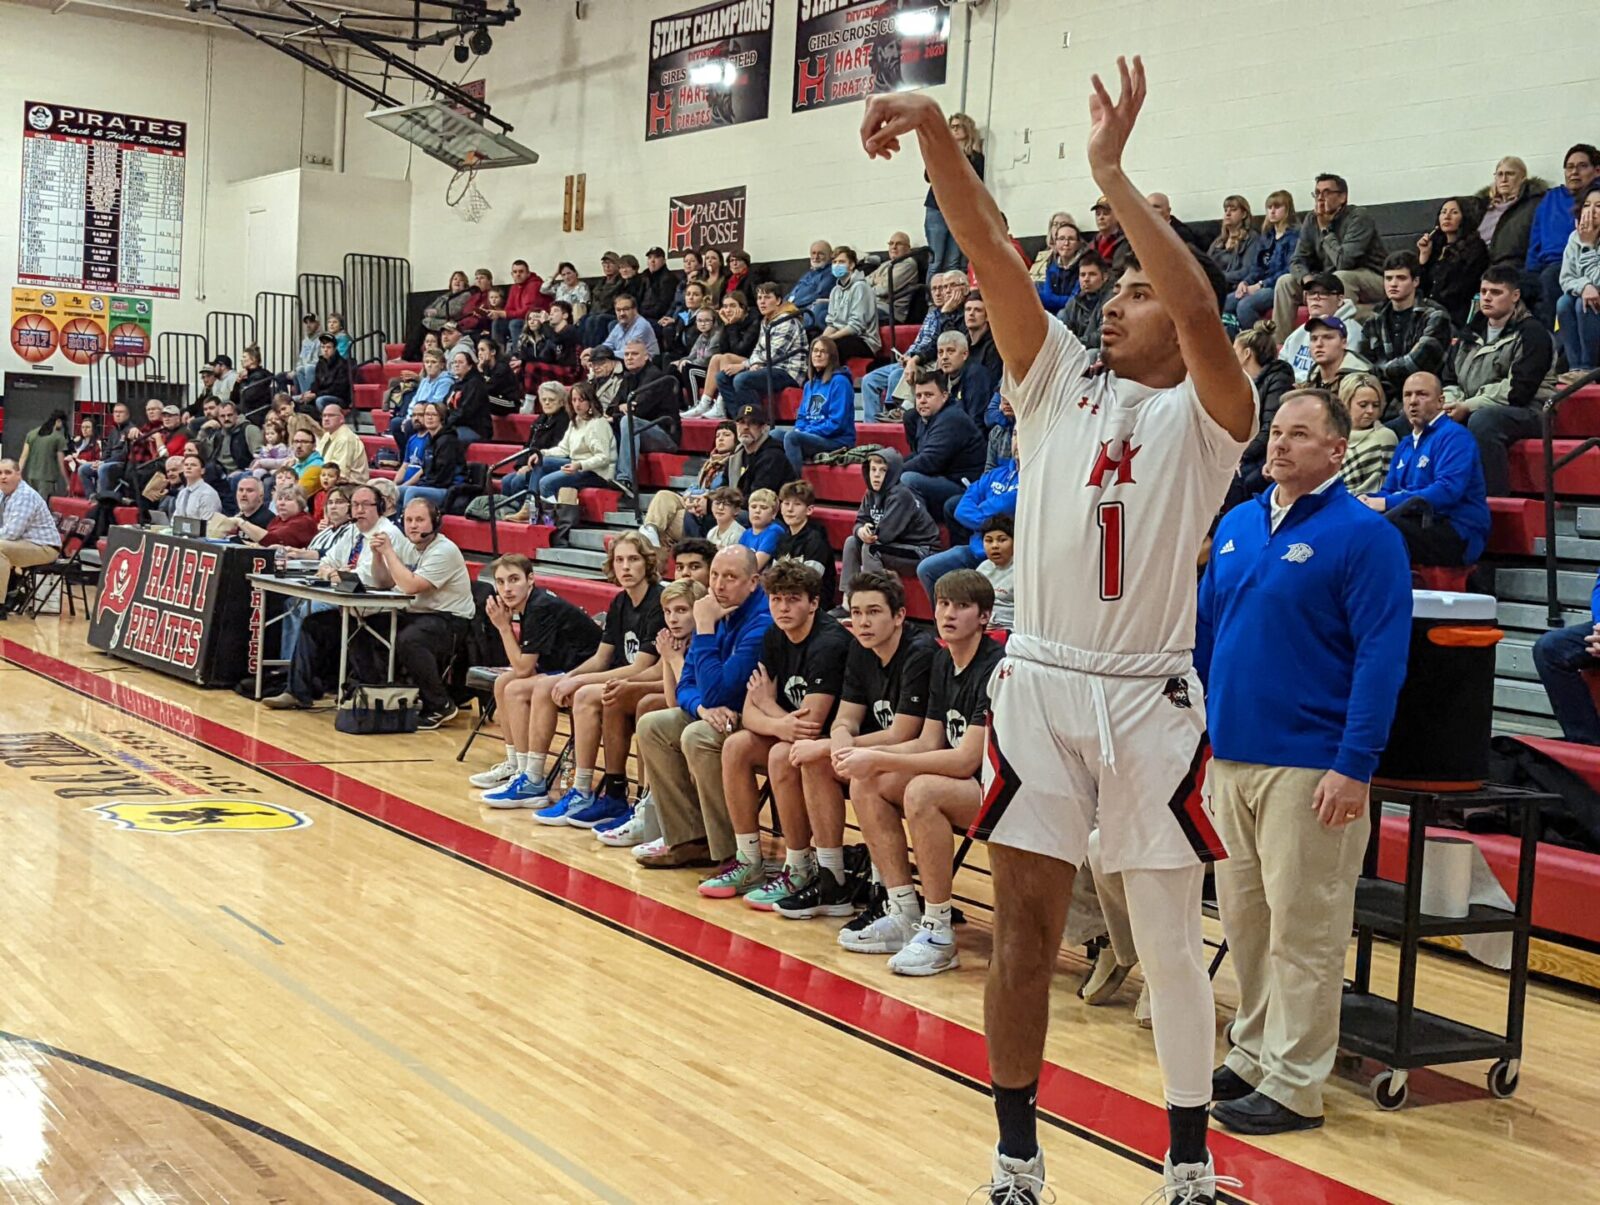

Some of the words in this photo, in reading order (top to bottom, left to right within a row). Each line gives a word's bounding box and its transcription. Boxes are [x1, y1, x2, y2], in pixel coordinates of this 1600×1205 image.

[652, 17, 692, 60] STATE
[692, 0, 772, 45] CHAMPIONS
[808, 32, 840, 52] GIRLS
[841, 21, 878, 43] CROSS
[833, 42, 874, 76] HART
[661, 68, 687, 86] GIRLS
[830, 74, 876, 100] PIRATES
[679, 85, 709, 108] HART
[59, 109, 182, 136] PIRATES
[675, 108, 712, 130] PIRATES
[57, 123, 89, 136] Track
[93, 128, 103, 137] &
[105, 129, 136, 142] Field
[139, 134, 180, 147] Records
[695, 197, 744, 223] PARENT
[700, 221, 738, 246] POSSE
[744, 405, 753, 415] P
[1085, 433, 1142, 488] H
[1097, 500, 1124, 601] 1
[143, 542, 218, 612] HART
[248, 557, 266, 674] PRATES
[123, 601, 204, 669] PIRATES
